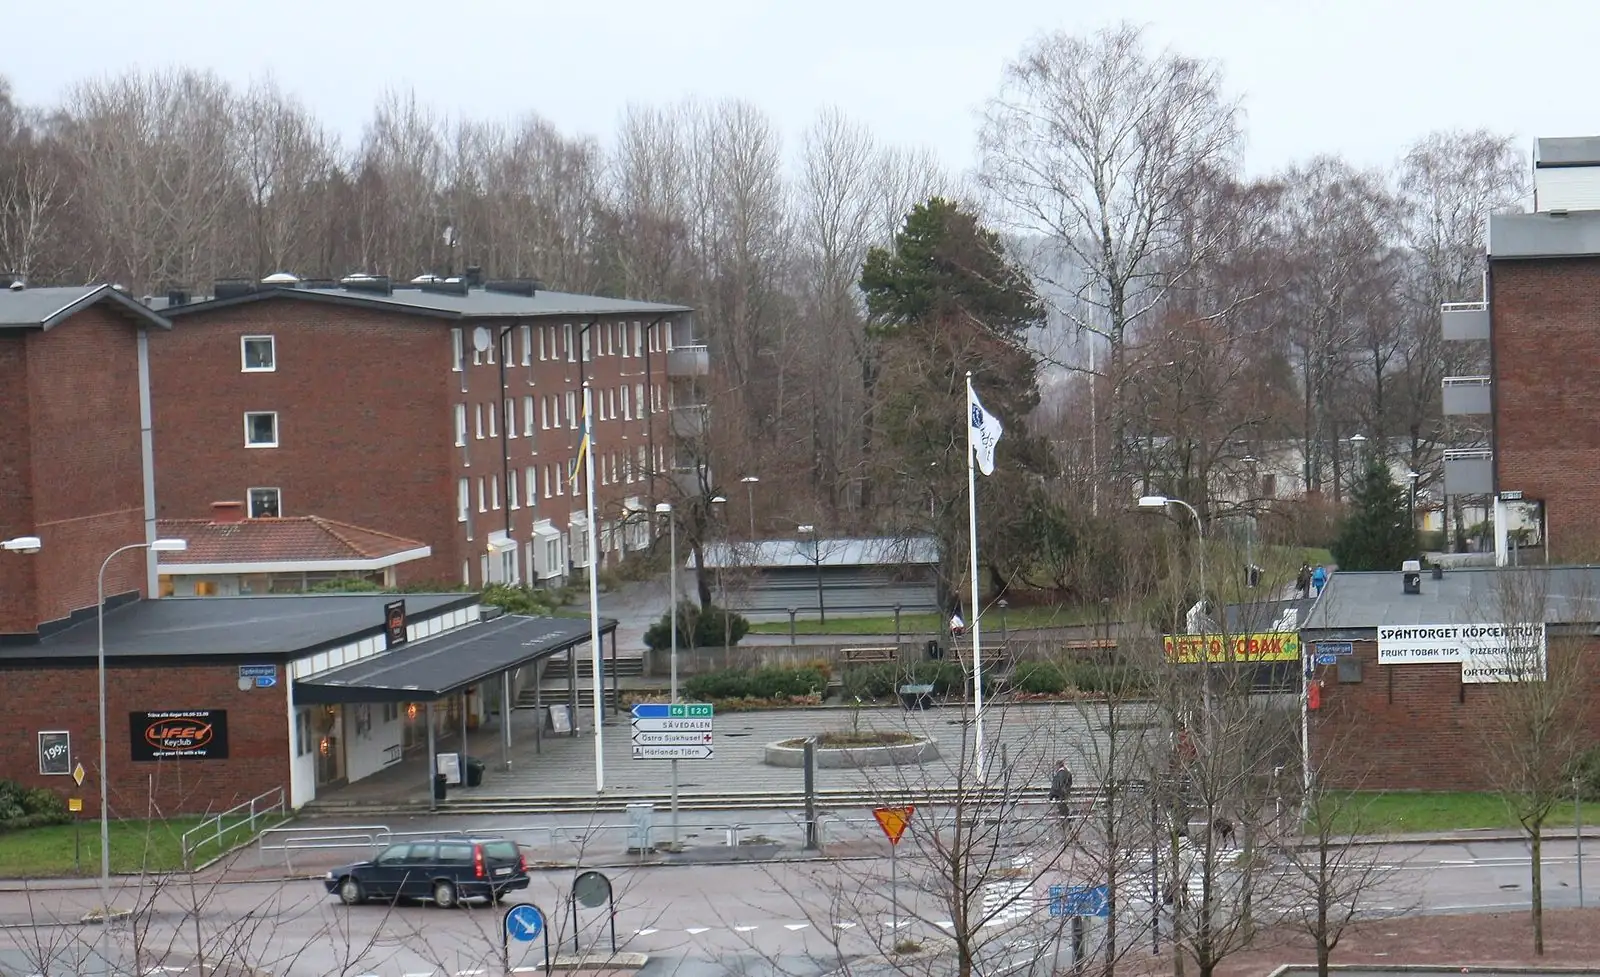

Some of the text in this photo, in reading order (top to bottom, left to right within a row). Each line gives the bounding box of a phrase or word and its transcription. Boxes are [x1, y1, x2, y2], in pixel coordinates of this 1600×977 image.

[1381, 649, 1407, 657] FRUKT
[1411, 648, 1439, 656] TOBAK
[1442, 648, 1460, 656] TIPS
[1470, 647, 1507, 655] PIZZERIA
[672, 707, 708, 715] E6 E20
[662, 721, 710, 729] SÄVEDALEN
[149, 728, 196, 738] LIFE
[641, 734, 701, 743] Östra Sjukhuset
